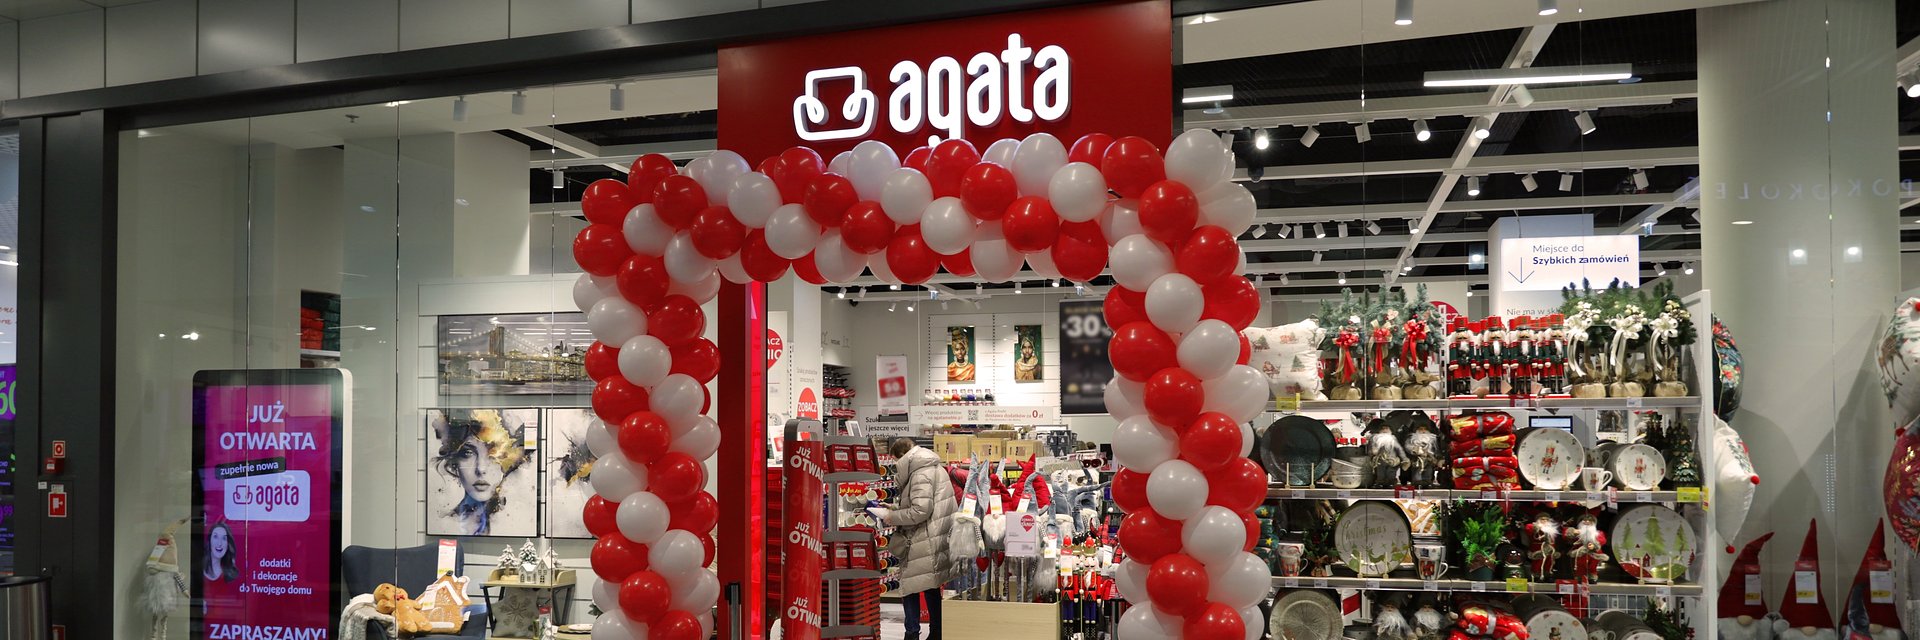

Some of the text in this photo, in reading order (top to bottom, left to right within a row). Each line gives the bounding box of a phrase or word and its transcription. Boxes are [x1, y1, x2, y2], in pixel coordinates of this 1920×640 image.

[888, 32, 1072, 147] agata
[1533, 244, 1584, 253] Miejsce do
[1532, 254, 1630, 266] Szybkich zamówień
[1506, 308, 1521, 316] Nie
[249, 400, 284, 423] JUŻ
[1032, 409, 1038, 418] 0
[219, 432, 316, 450] OTWARTA
[796, 446, 811, 459] JUŻ
[220, 461, 279, 476] zupełnie nowa
[255, 482, 299, 512] agata
[795, 521, 810, 534] JUŻ
[260, 558, 291, 568] dodatki
[252, 571, 298, 582] i dekoracje
[251, 584, 286, 595] Twojego
[287, 586, 312, 595] domu
[793, 596, 808, 609] JUŻ
[209, 623, 327, 640] ZAPRASZAMY!
